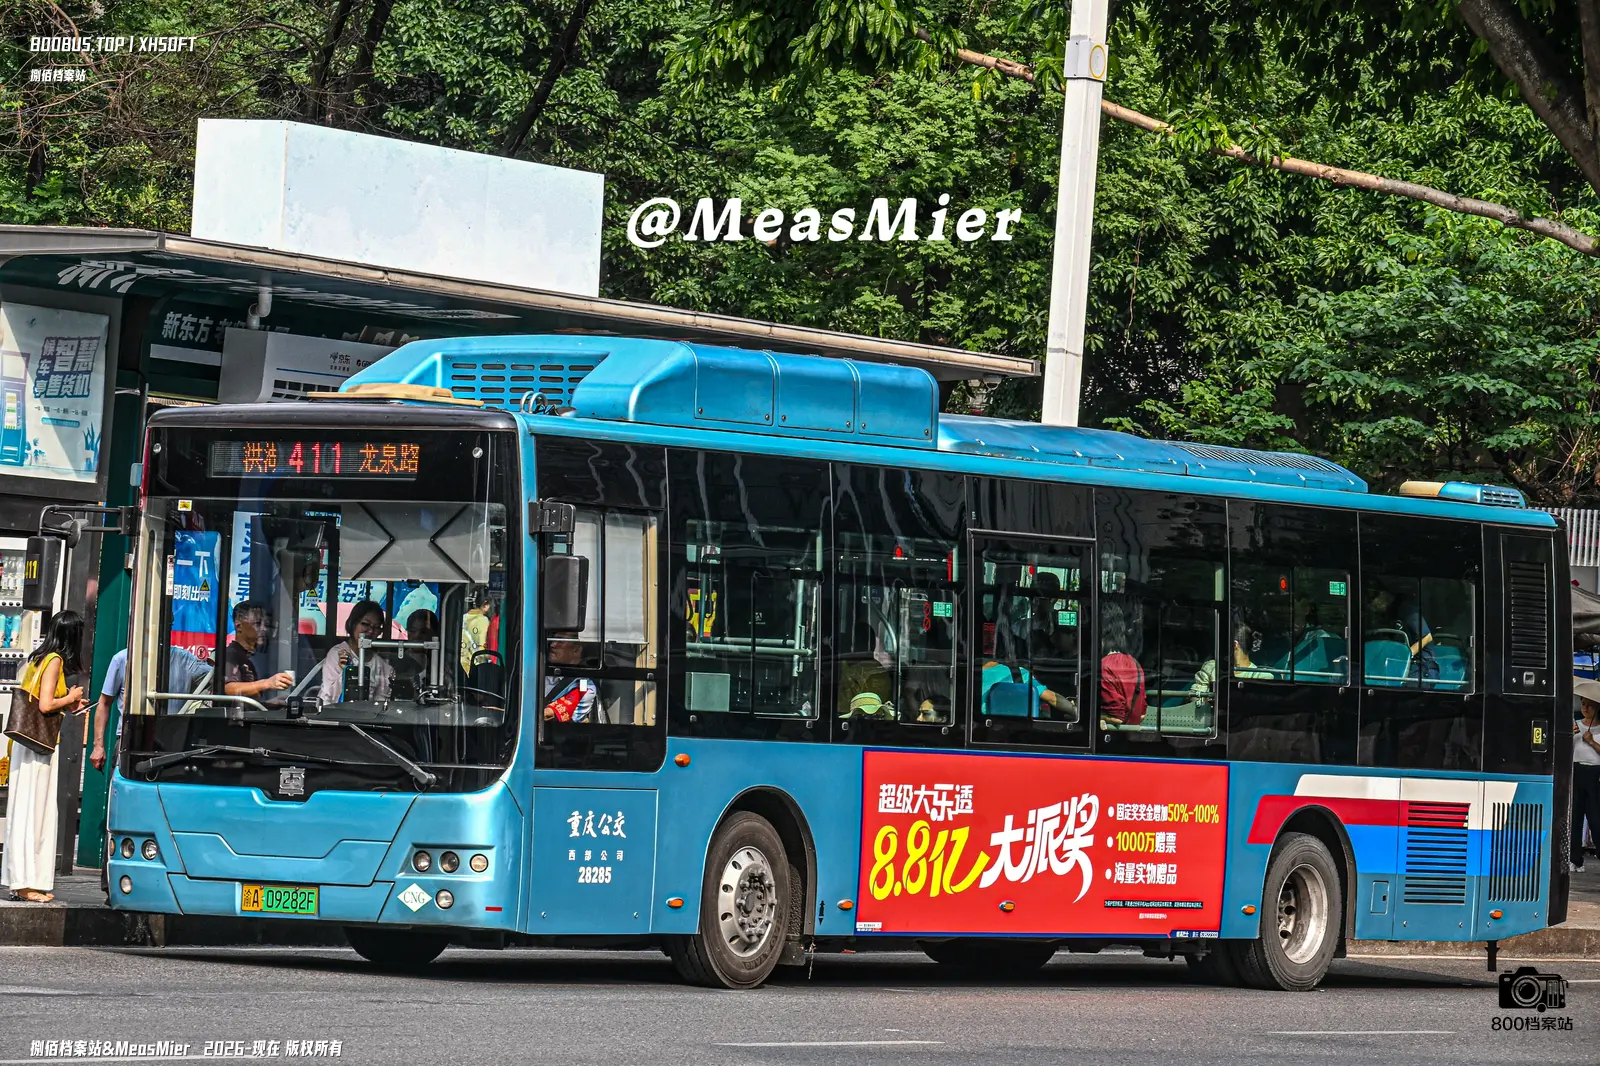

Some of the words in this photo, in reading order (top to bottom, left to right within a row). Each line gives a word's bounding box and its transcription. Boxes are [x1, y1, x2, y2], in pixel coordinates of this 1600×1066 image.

[162, 311, 213, 343] 新东方
[288, 441, 342, 474] 411
[358, 442, 420, 474] 龙泉路
[878, 783, 974, 821] 超级大乐透
[567, 810, 627, 838] 重庆公交
[1116, 831, 1177, 853] 1000万赠票
[568, 849, 624, 862] 西部公司
[578, 866, 612, 884] 28285
[1113, 862, 1177, 885] 海量实物赠品
[403, 891, 425, 904] CNG
